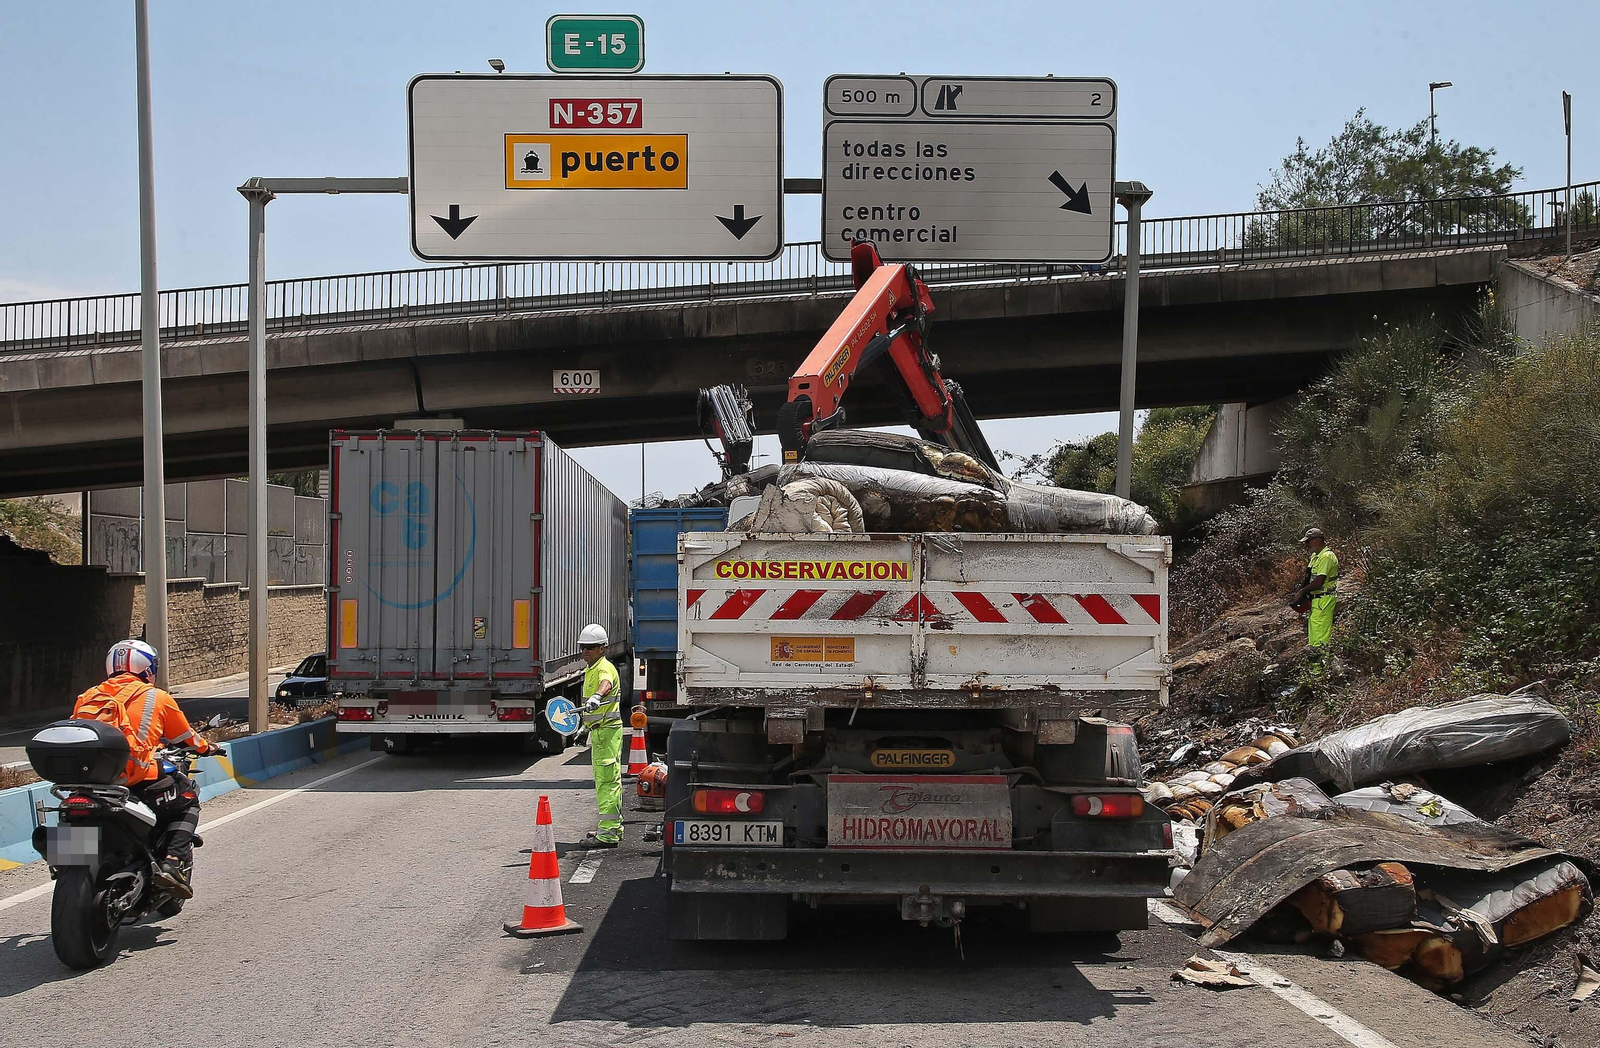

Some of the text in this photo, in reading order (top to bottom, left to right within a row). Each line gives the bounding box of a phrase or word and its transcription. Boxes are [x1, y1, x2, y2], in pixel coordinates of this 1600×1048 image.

[564, 33, 627, 55] E-15
[841, 89, 900, 104] 500 m
[1091, 92, 1102, 106] 2
[553, 102, 639, 125] N-357
[843, 139, 948, 158] todas las
[561, 145, 680, 178] puerto
[842, 163, 976, 181] direcciones
[842, 202, 921, 221] centro
[841, 225, 957, 243] comercial
[825, 349, 849, 384] PALFINGER
[560, 372, 593, 388] 6,00
[716, 561, 908, 579] CONSERVACION
[876, 753, 951, 765] PALFINGER
[689, 823, 778, 843] 8391 KTM
[842, 817, 1004, 842] HIDROMAYORAL
